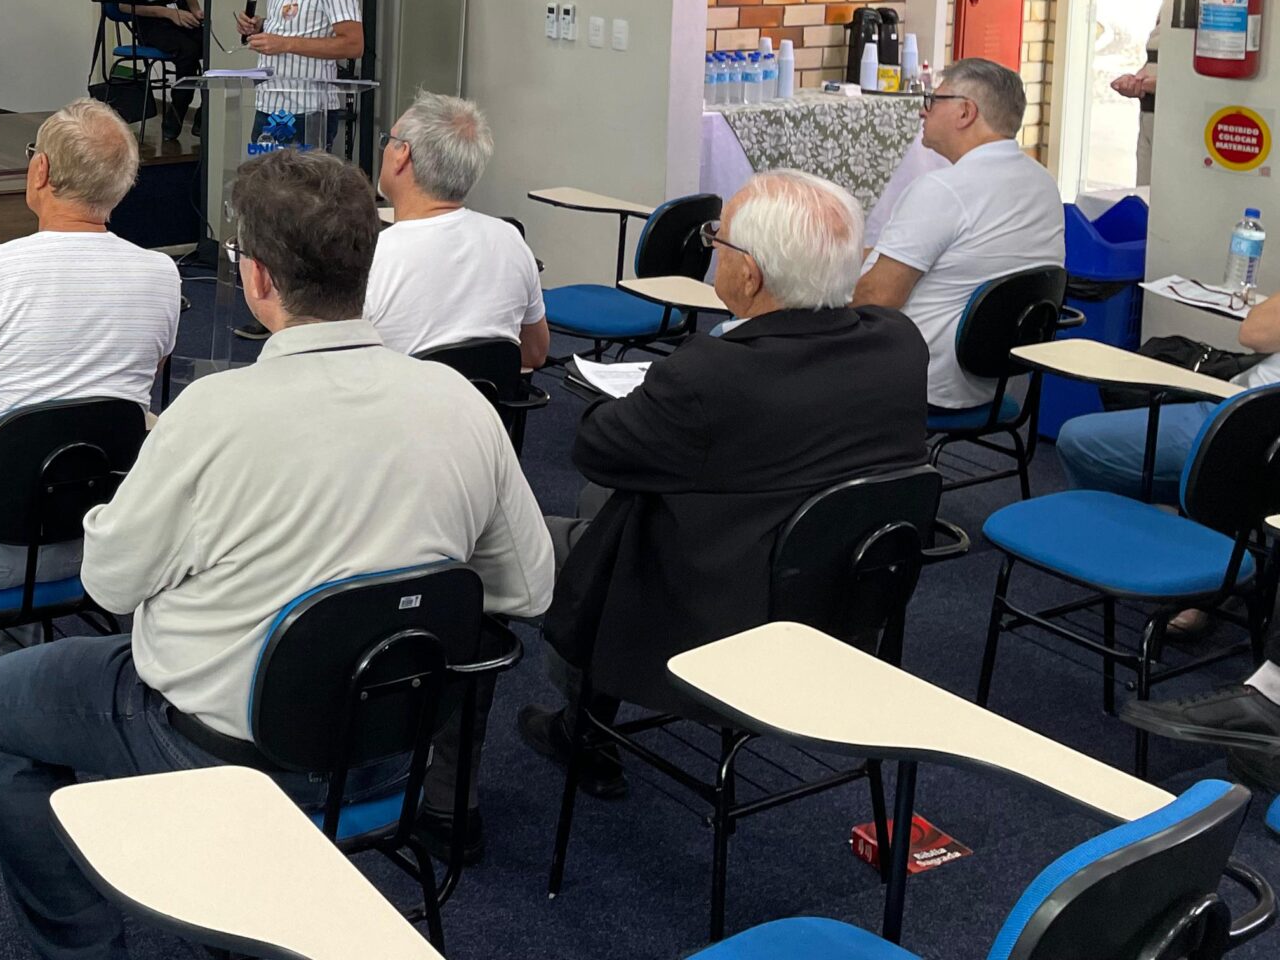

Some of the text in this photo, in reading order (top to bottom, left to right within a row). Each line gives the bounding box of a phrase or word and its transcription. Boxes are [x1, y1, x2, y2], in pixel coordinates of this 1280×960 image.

[1217, 124, 1259, 136] PROIBIDO
[1218, 133, 1257, 144] COLOCAR
[1215, 141, 1259, 154] MATERIAIS
